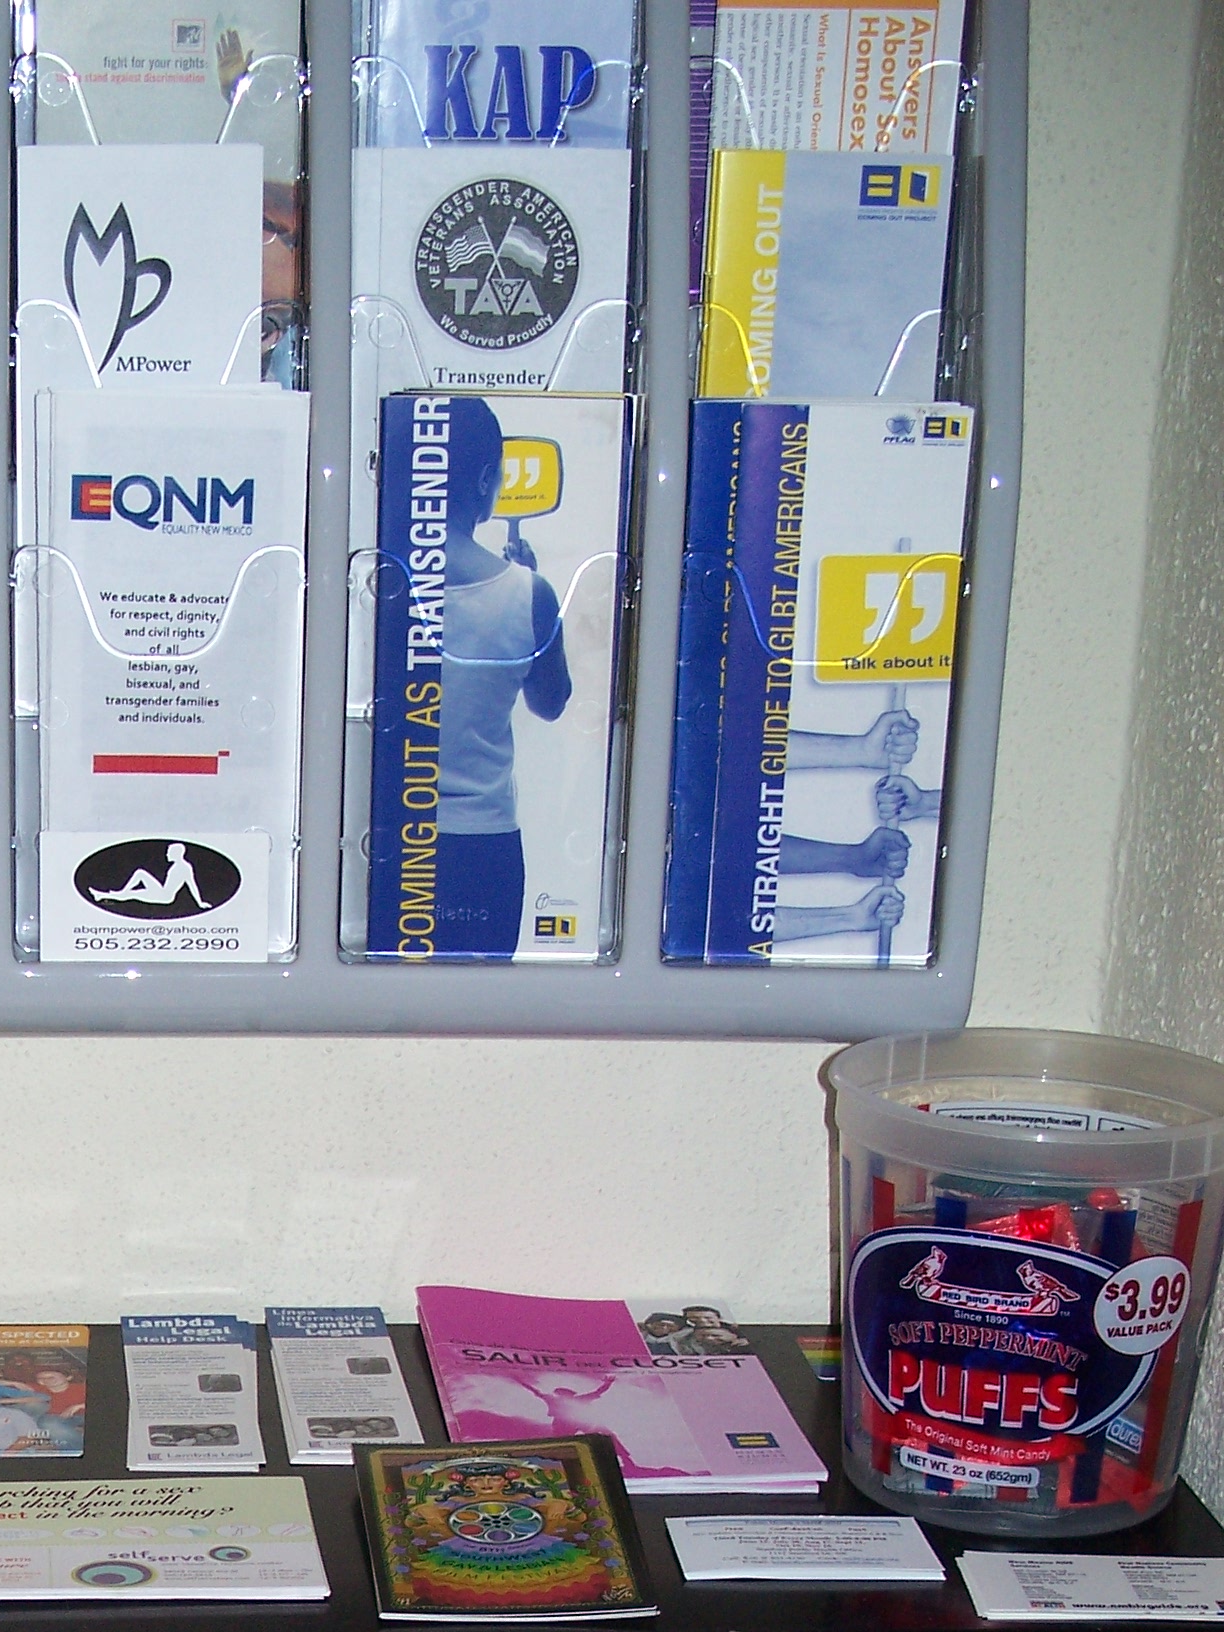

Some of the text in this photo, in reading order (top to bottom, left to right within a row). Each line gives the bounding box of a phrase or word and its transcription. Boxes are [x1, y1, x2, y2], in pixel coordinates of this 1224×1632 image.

[423, 43, 597, 142] KAP
[439, 313, 554, 348] We Served Proudly
[116, 355, 192, 375] MPower
[434, 367, 545, 388] Transgender
[71, 474, 255, 526] EQNM
[842, 657, 876, 670] Talk
[883, 655, 933, 670] about
[398, 396, 451, 959] COMING OUT AS TRANSGENDER
[748, 422, 810, 960] A STRAIGHT GUIDE TO GLBT AMERICANS
[73, 924, 239, 938] abqmpower@yahoo.com
[74, 937, 240, 952] 505.232.2990
[942, 1291, 1030, 1309] RED BIRD BRAND
[1105, 1272, 1186, 1321] $3.99
[128, 1316, 216, 1329] Lambda
[954, 1310, 1009, 1325] Since 1890
[171, 1326, 232, 1337] Legal
[1106, 1320, 1173, 1339] VALUE PACK
[888, 1321, 1088, 1372] SOFT PEPPERMINT
[462, 1349, 568, 1368] SALIR
[888, 1349, 1080, 1431] PUFFS
[905, 1418, 1051, 1462] The Original Soft Mint Candy
[907, 1453, 925, 1467] NET
[952, 1463, 966, 1475] 23
[967, 1468, 983, 1479] oz
[985, 1468, 1032, 1484] (652gm)
